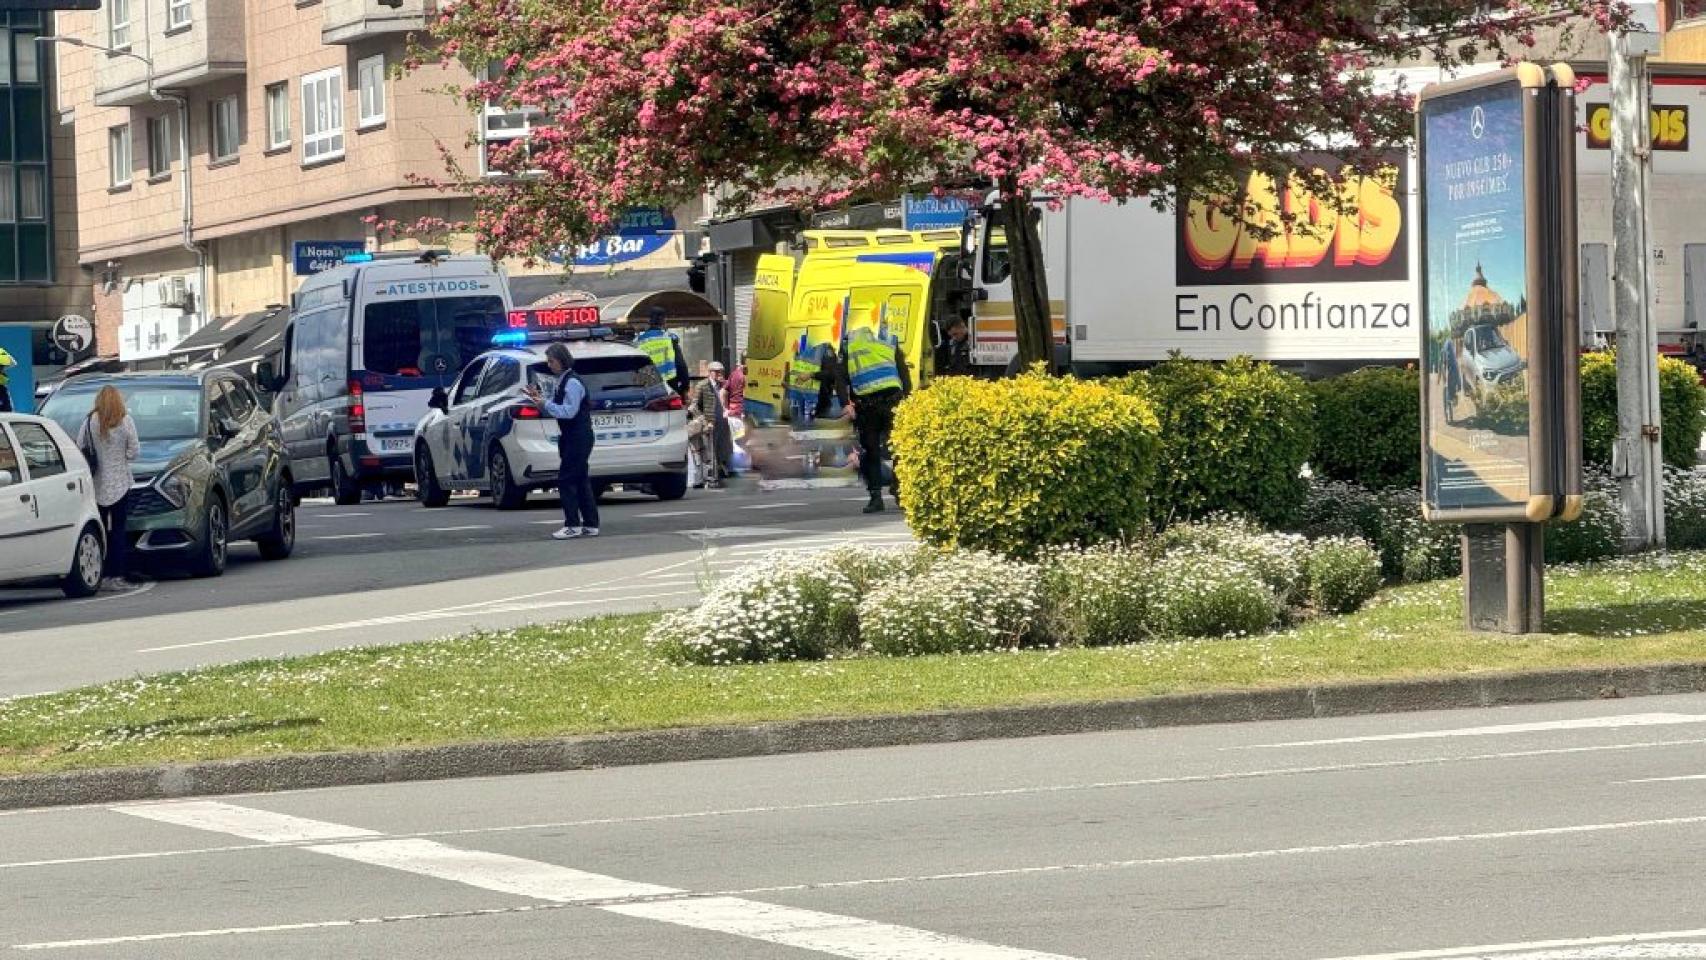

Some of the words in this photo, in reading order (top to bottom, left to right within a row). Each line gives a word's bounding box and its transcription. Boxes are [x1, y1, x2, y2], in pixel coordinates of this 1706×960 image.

[606, 235, 644, 256] Bar
[387, 279, 479, 296] ATESTADOS
[509, 311, 528, 328] DE
[1175, 294, 1221, 331] En
[1230, 291, 1411, 330] Confianza
